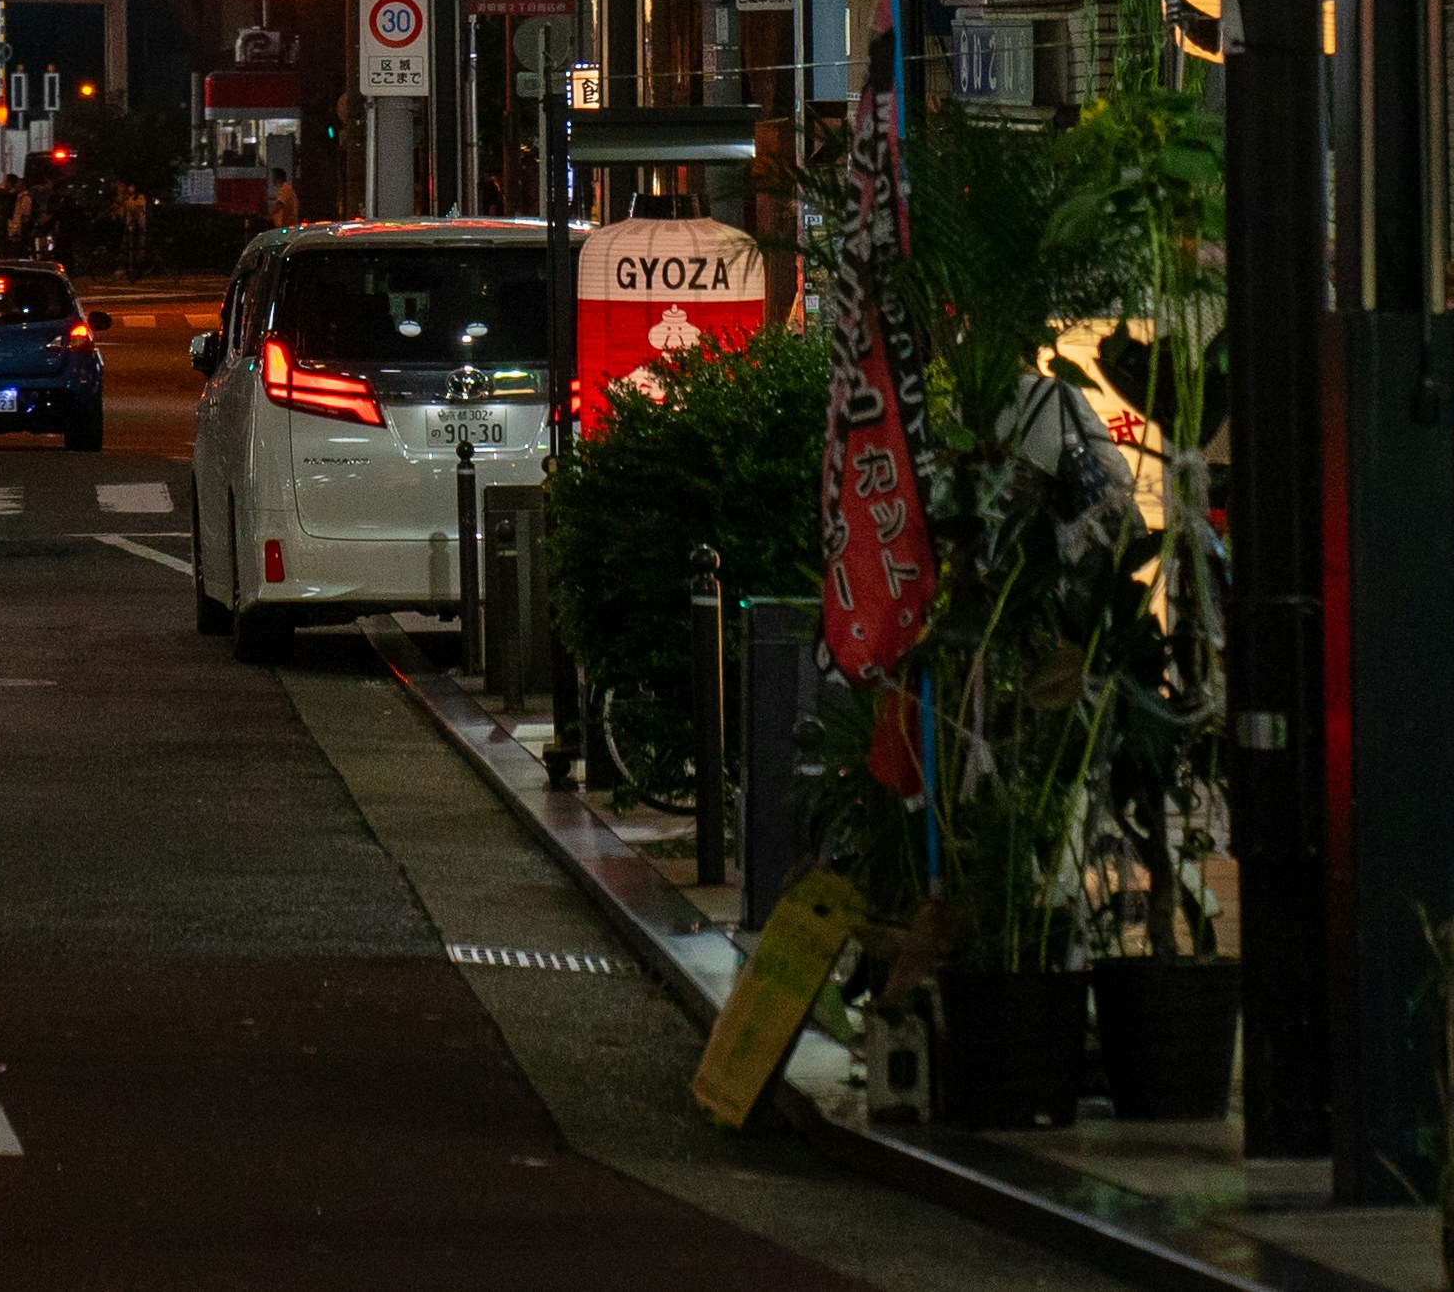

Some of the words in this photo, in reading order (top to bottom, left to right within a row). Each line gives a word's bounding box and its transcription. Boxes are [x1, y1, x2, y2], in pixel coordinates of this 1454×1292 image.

[381, 8, 411, 34] 30
[380, 58, 412, 72] 区域
[370, 71, 422, 86] ここまで
[615, 256, 731, 291] GYOZA
[444, 423, 503, 444] 90-30
